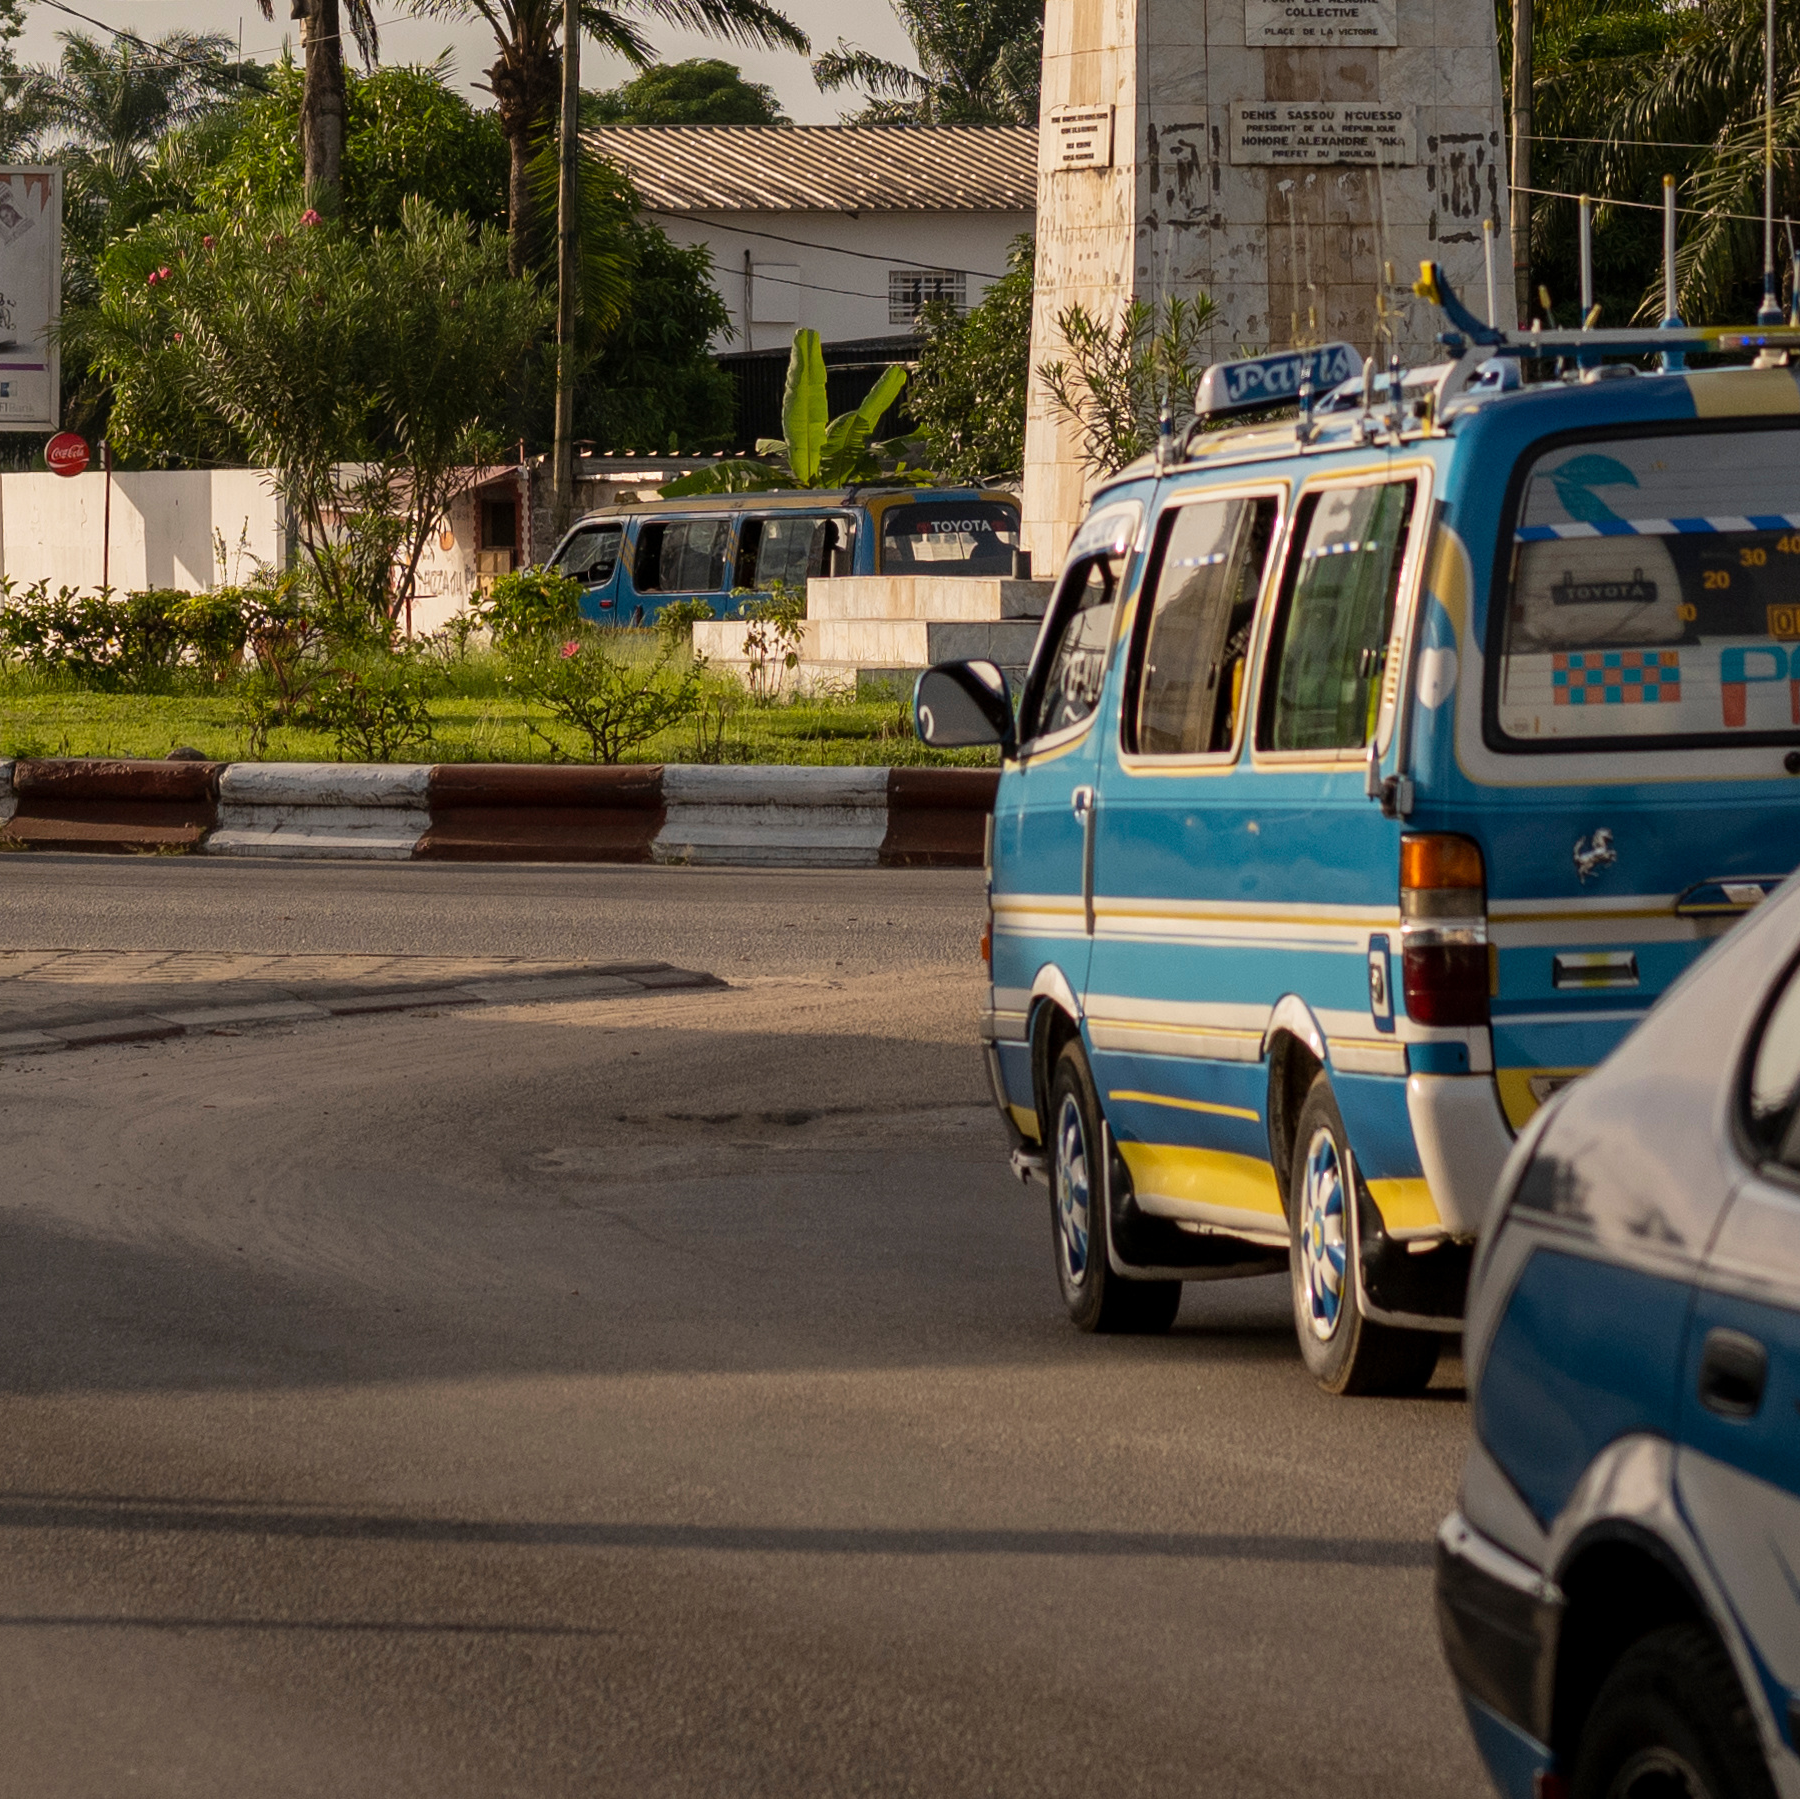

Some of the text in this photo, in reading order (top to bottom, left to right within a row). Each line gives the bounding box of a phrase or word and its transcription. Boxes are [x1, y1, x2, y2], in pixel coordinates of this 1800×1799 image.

[1285, 8, 1359, 17] COLLECTIVE
[1242, 111, 1277, 120] DENIS
[1288, 111, 1334, 120] SASSOU
[1242, 136, 1289, 146] HONORE
[1297, 136, 1368, 146] ALEXANDRE
[1230, 350, 1351, 399] Paris
[931, 520, 992, 532] TOYOTA
[1740, 548, 1767, 567] 30
[1704, 571, 1730, 589] 20
[1565, 584, 1645, 599] TOYOTA
